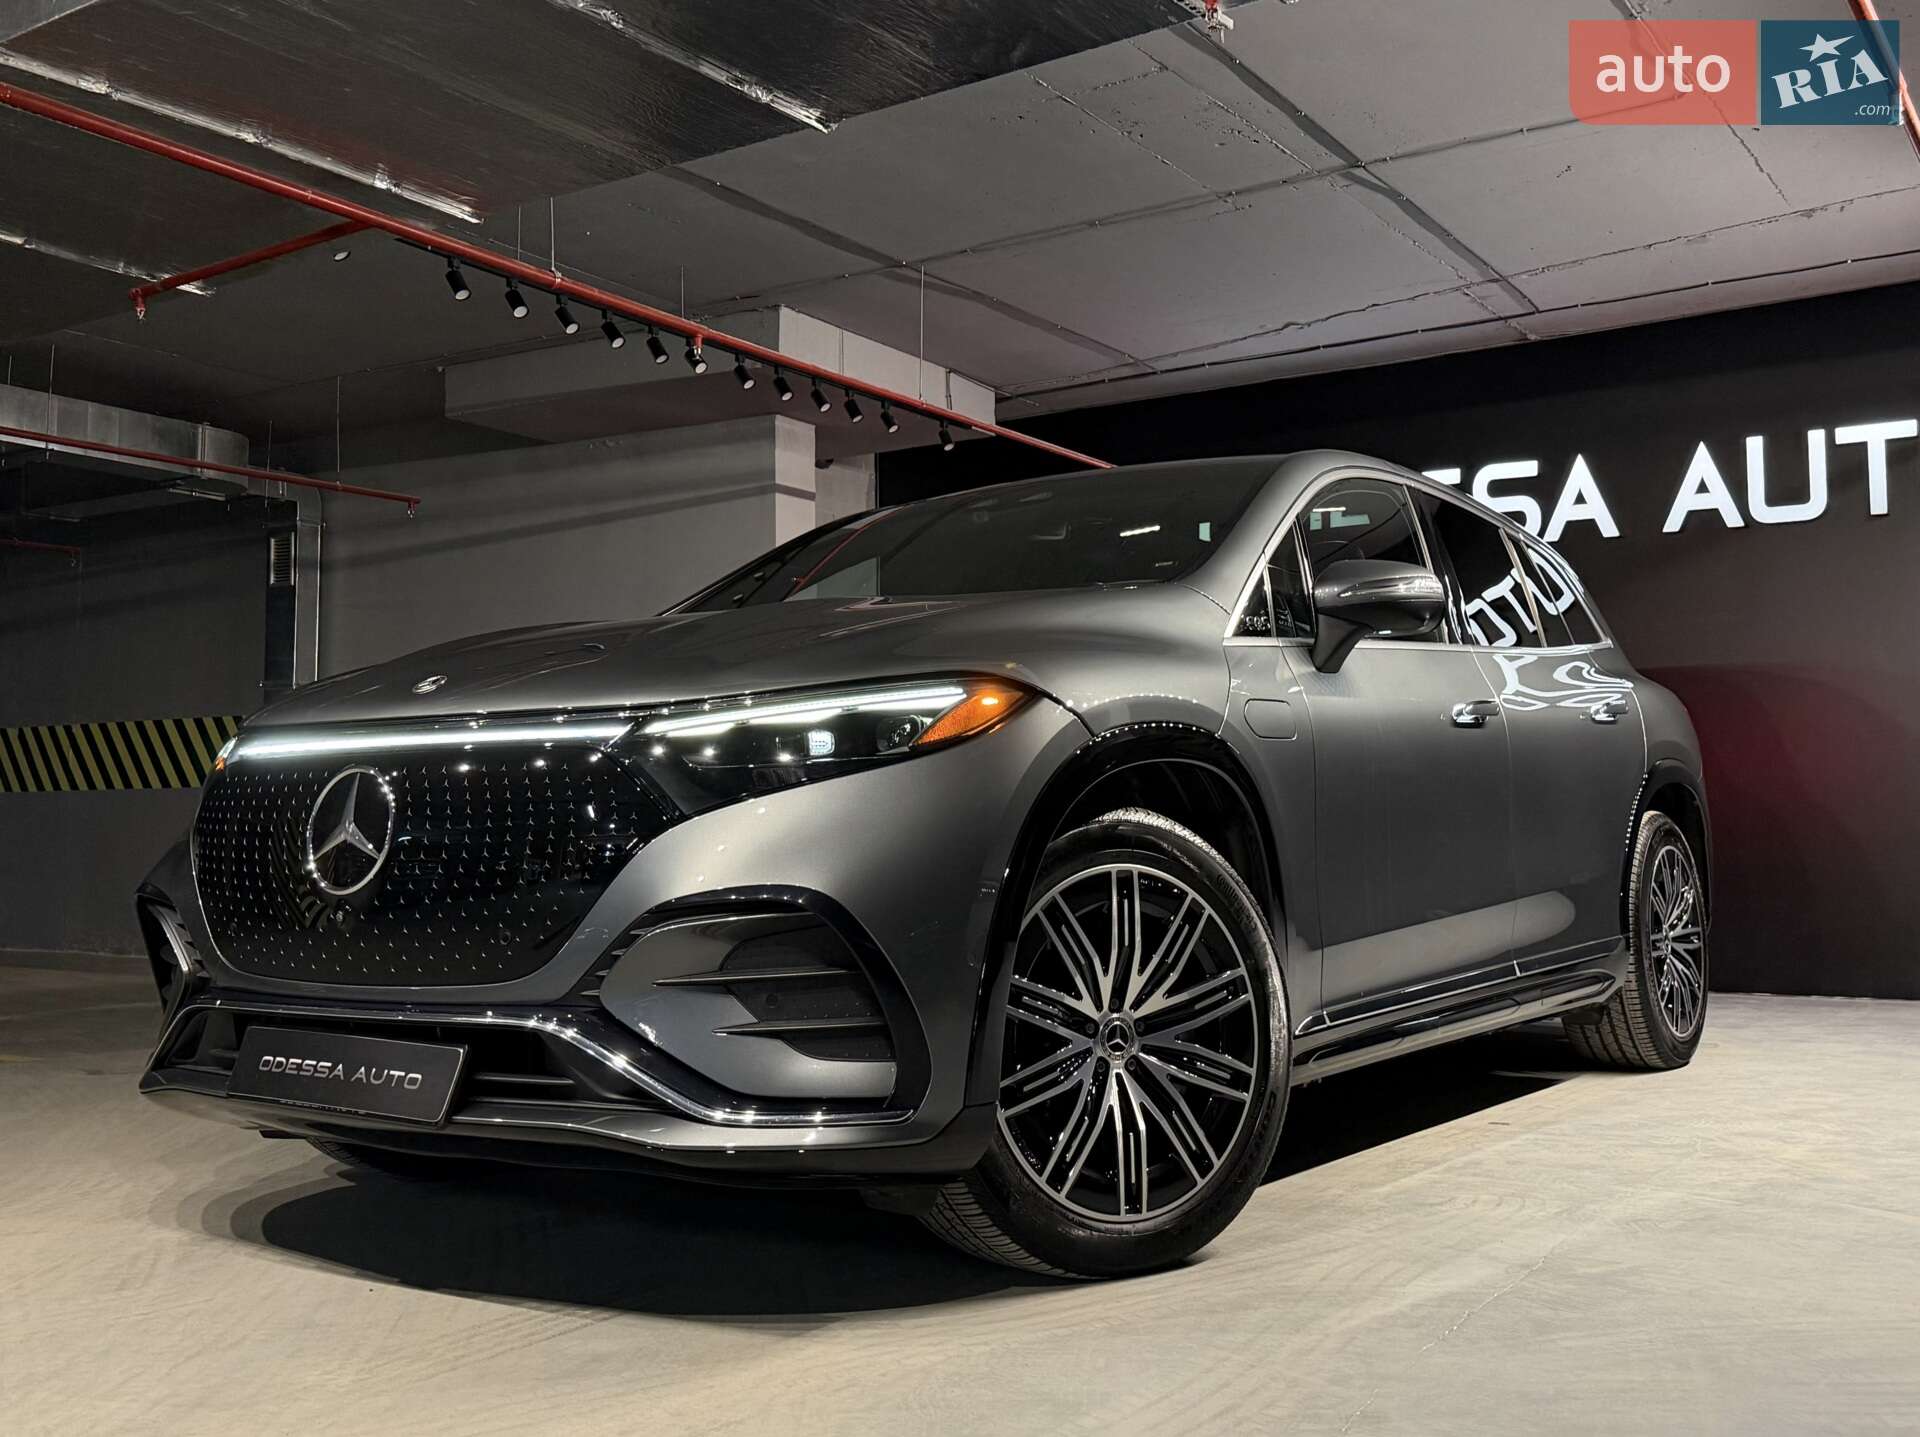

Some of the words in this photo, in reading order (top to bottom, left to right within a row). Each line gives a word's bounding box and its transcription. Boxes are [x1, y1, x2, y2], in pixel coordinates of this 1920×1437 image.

[1421, 453, 1621, 542] SA
[1662, 418, 1918, 533] AUT
[258, 1055, 345, 1081] ODESSA
[351, 1065, 423, 1090] AUTO
